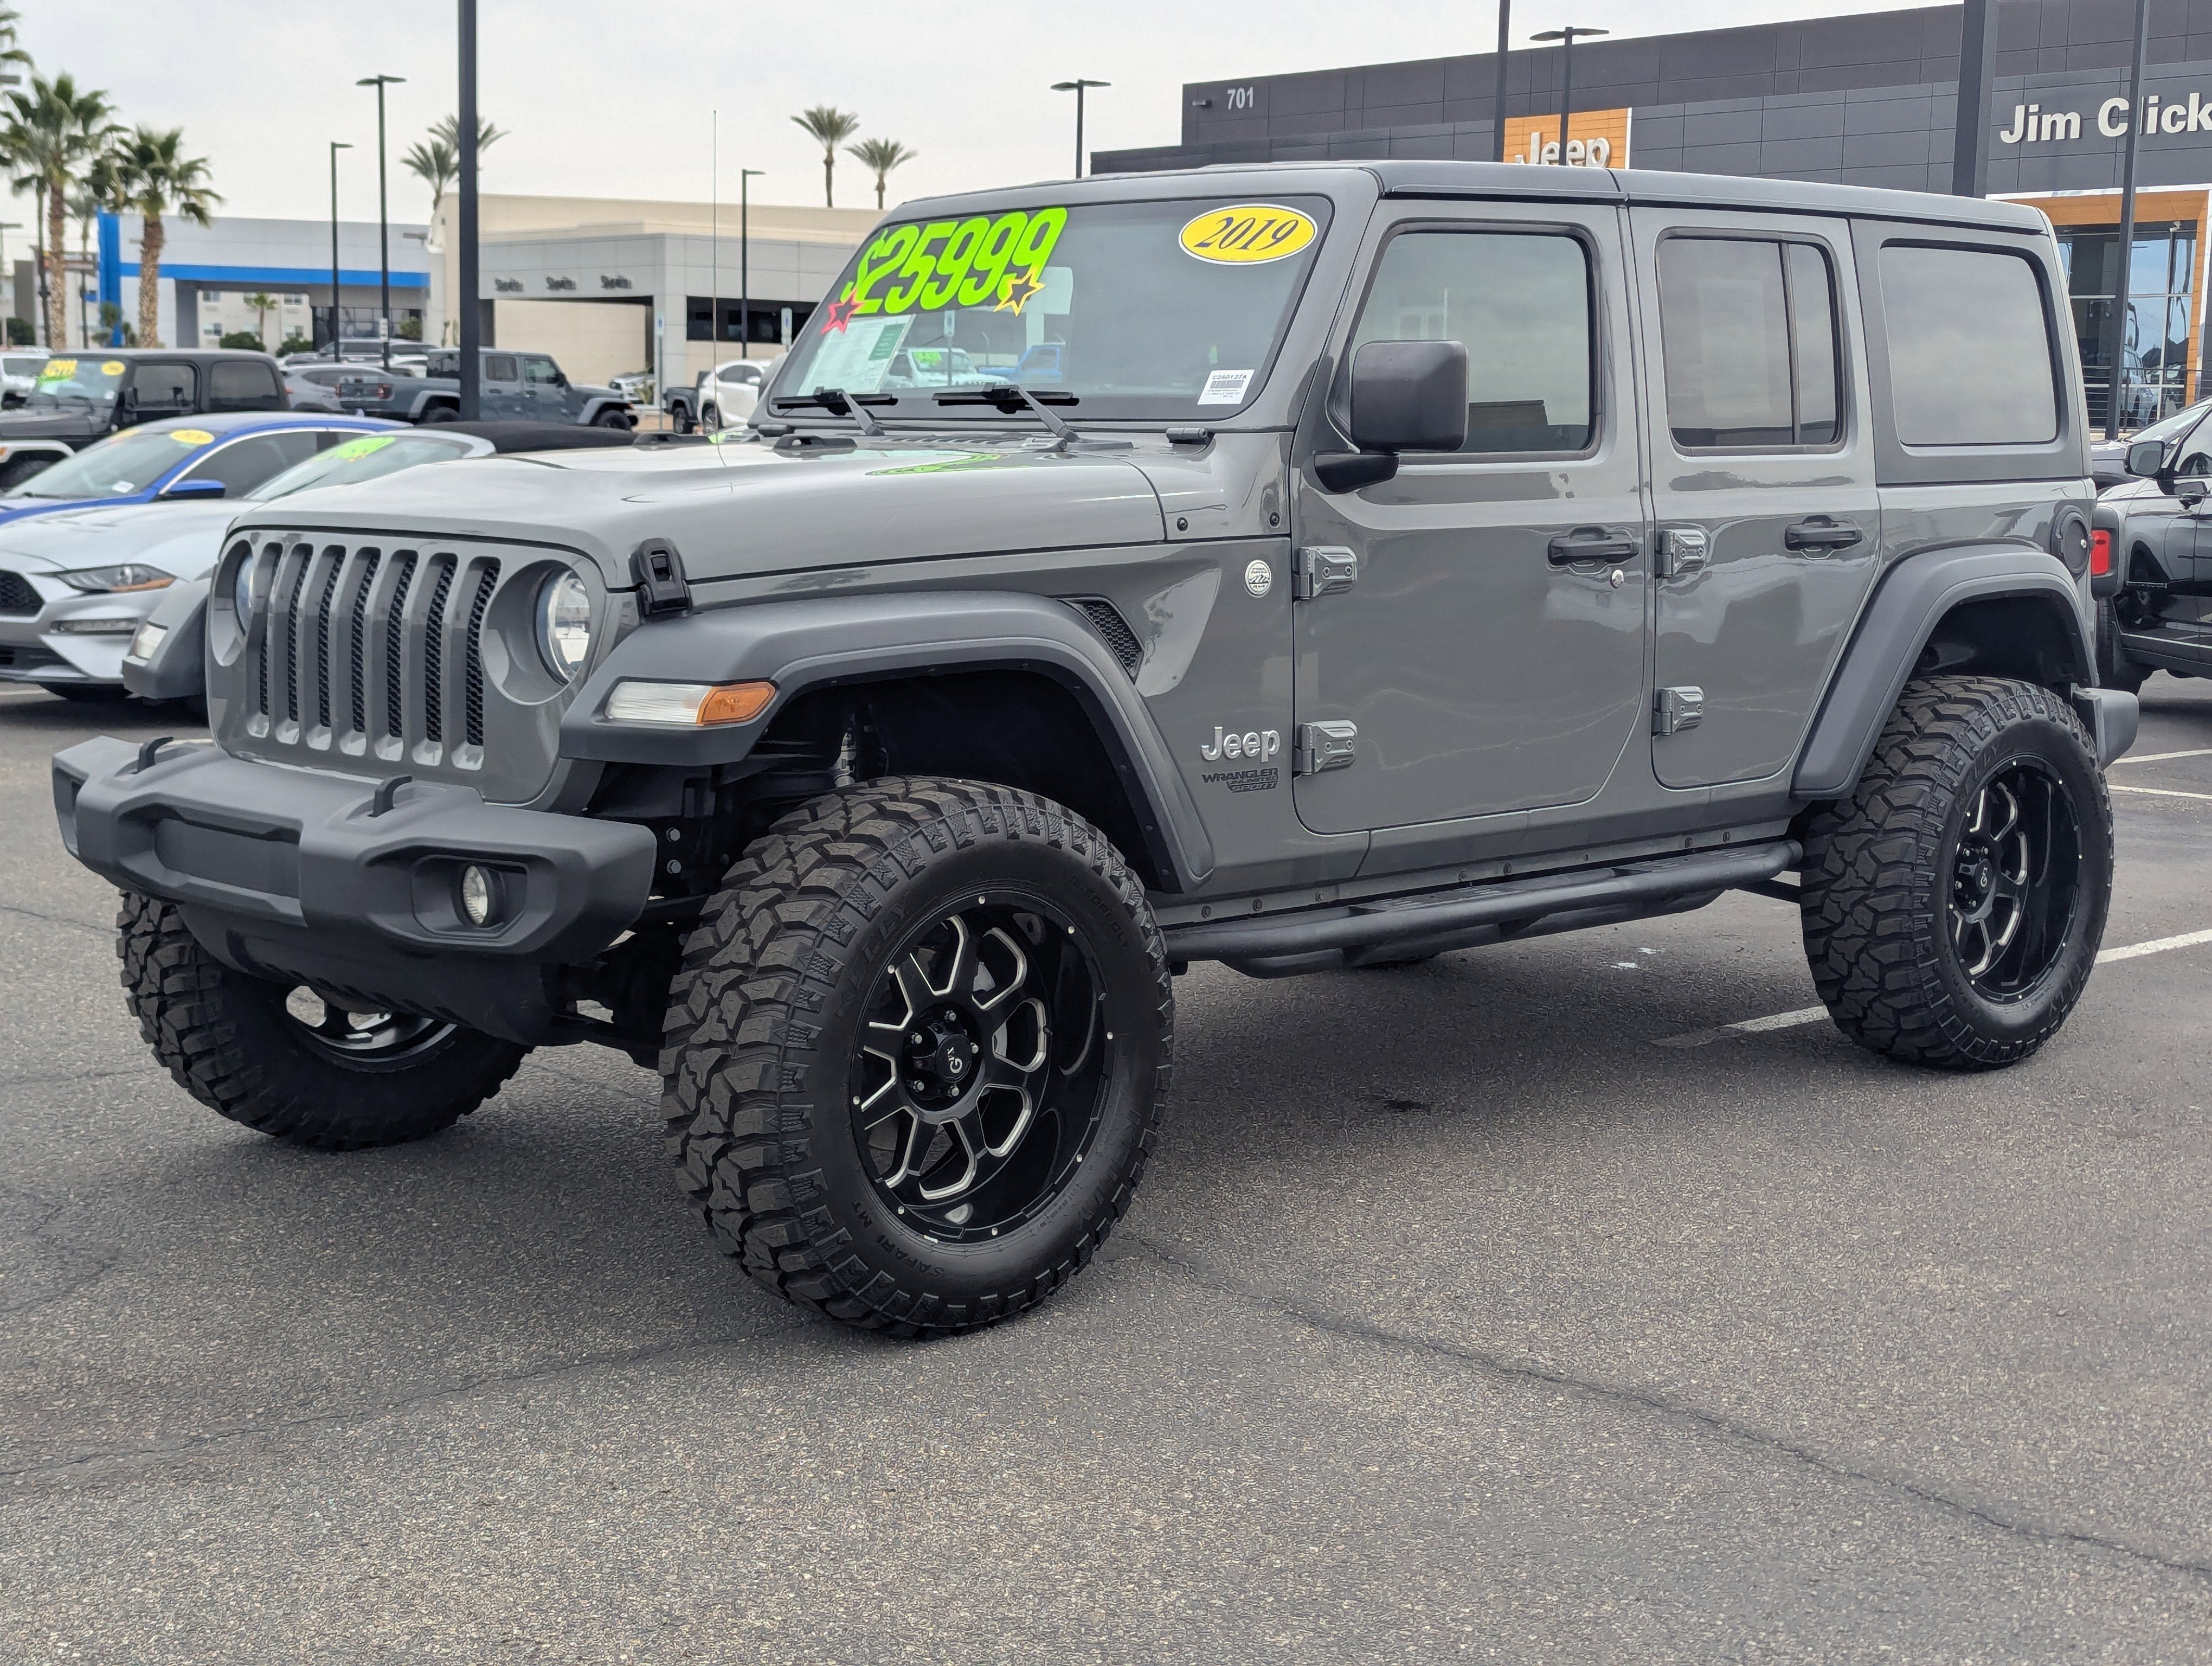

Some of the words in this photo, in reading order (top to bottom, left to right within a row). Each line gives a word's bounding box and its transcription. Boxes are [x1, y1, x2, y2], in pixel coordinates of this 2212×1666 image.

[1227, 86, 1253, 110] 701
[2000, 104, 2081, 144] Jim
[2098, 92, 2212, 137] Cick
[1514, 131, 1610, 169] Jeep
[1193, 216, 1300, 252] 2019
[840, 207, 1068, 315] $25999
[1201, 726, 1281, 763] Jeep
[1201, 767, 1278, 783] WRANGLER
[876, 1234, 946, 1277] SAFARI
